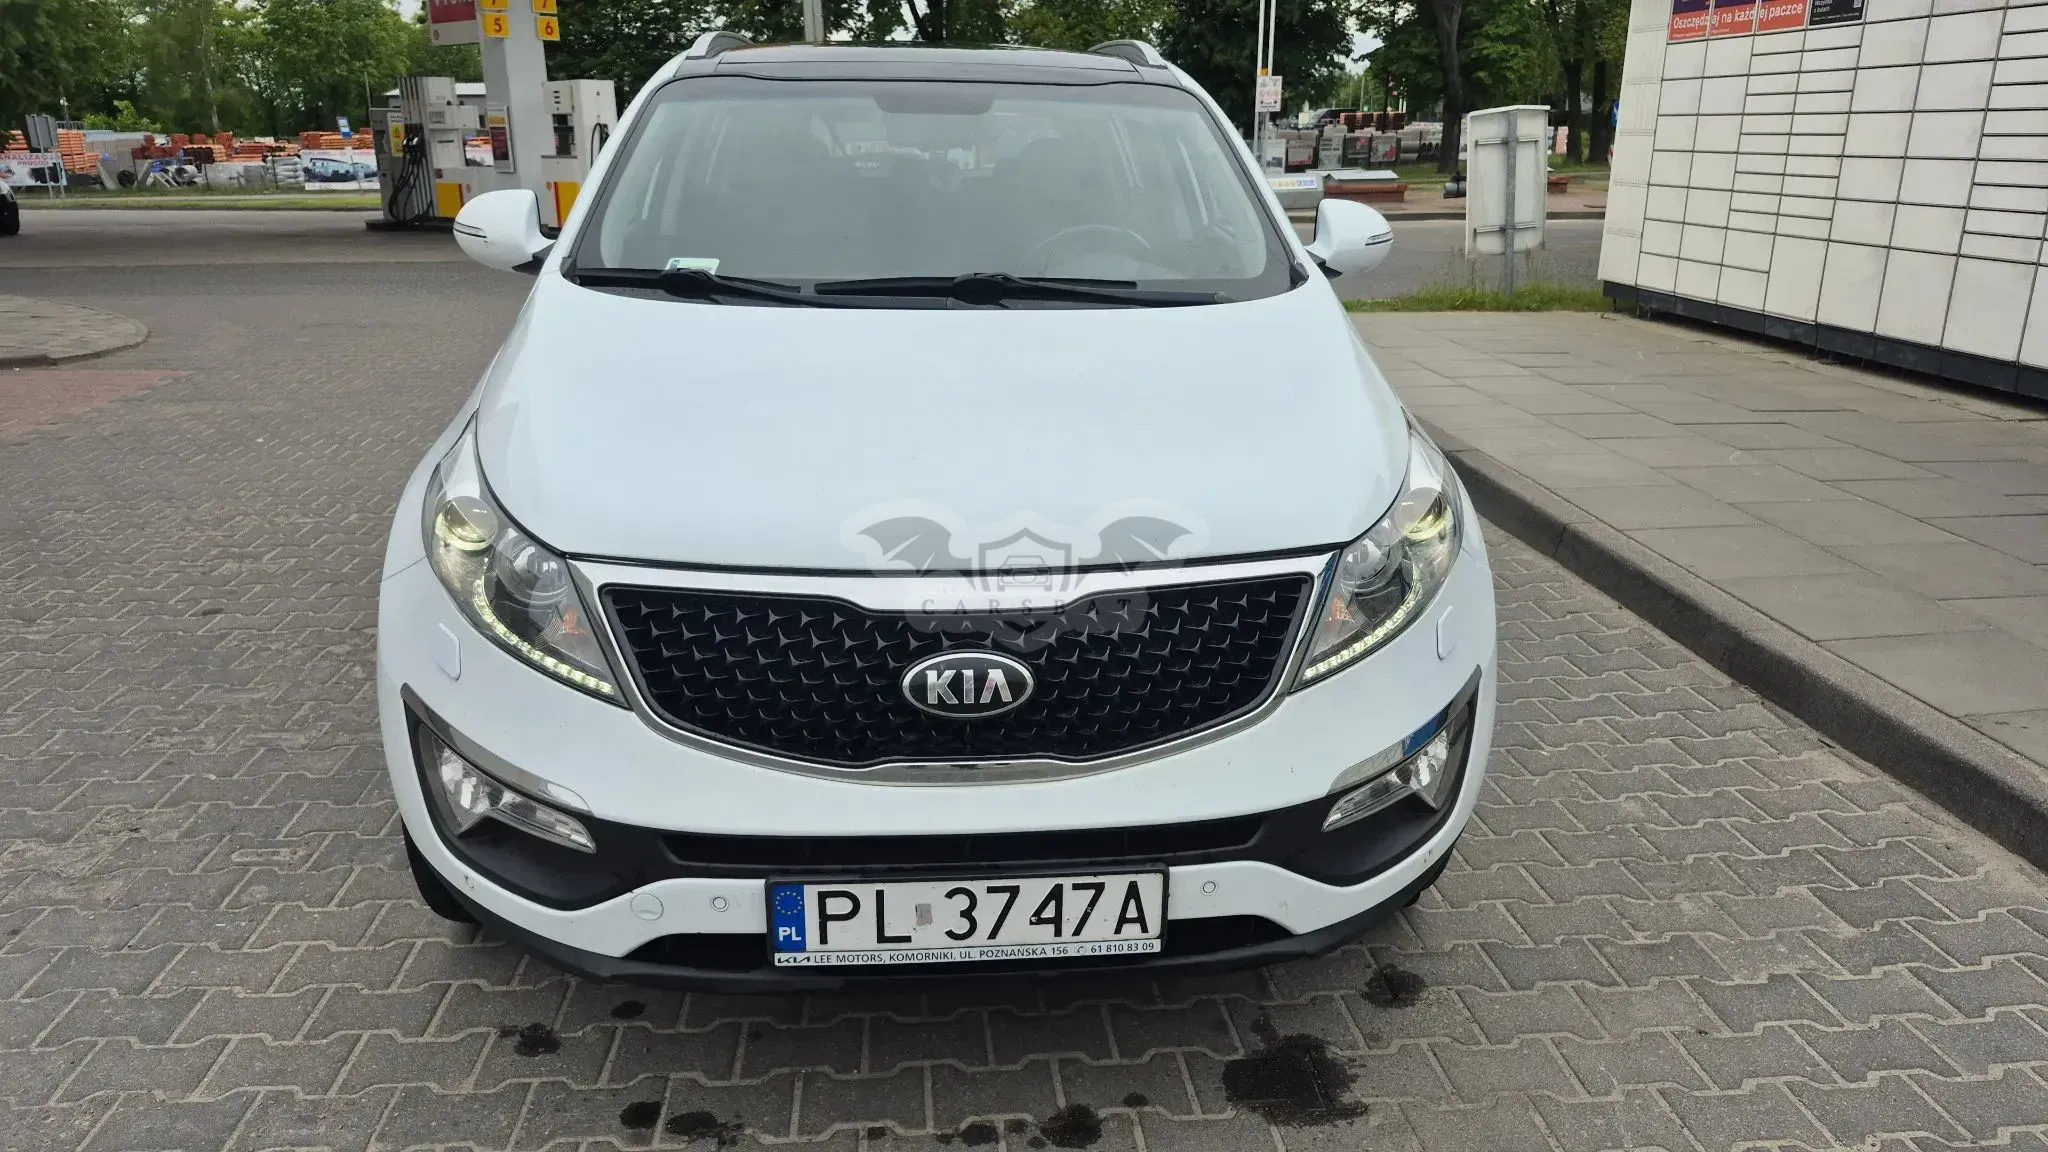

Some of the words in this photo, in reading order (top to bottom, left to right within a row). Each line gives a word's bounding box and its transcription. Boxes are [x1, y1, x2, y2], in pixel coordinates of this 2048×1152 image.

[1721, 14, 1732, 23] na
[1769, 3, 1803, 19] paczce
[493, 17, 503, 33] 5
[545, 20, 554, 36] 6
[925, 668, 1013, 705] KIA
[817, 889, 912, 945] PL
[943, 879, 1150, 941] 3747A
[777, 926, 802, 942] PL
[814, 954, 832, 964] LEE
[836, 952, 886, 964] MOTORS,
[889, 951, 956, 962] KOMORNIKI,
[959, 950, 976, 960] UL.
[1051, 946, 1069, 955] 156
[1090, 944, 1102, 953] 61
[1106, 943, 1125, 953] 810
[1126, 942, 1139, 952] 83
[1142, 942, 1154, 951] 09
